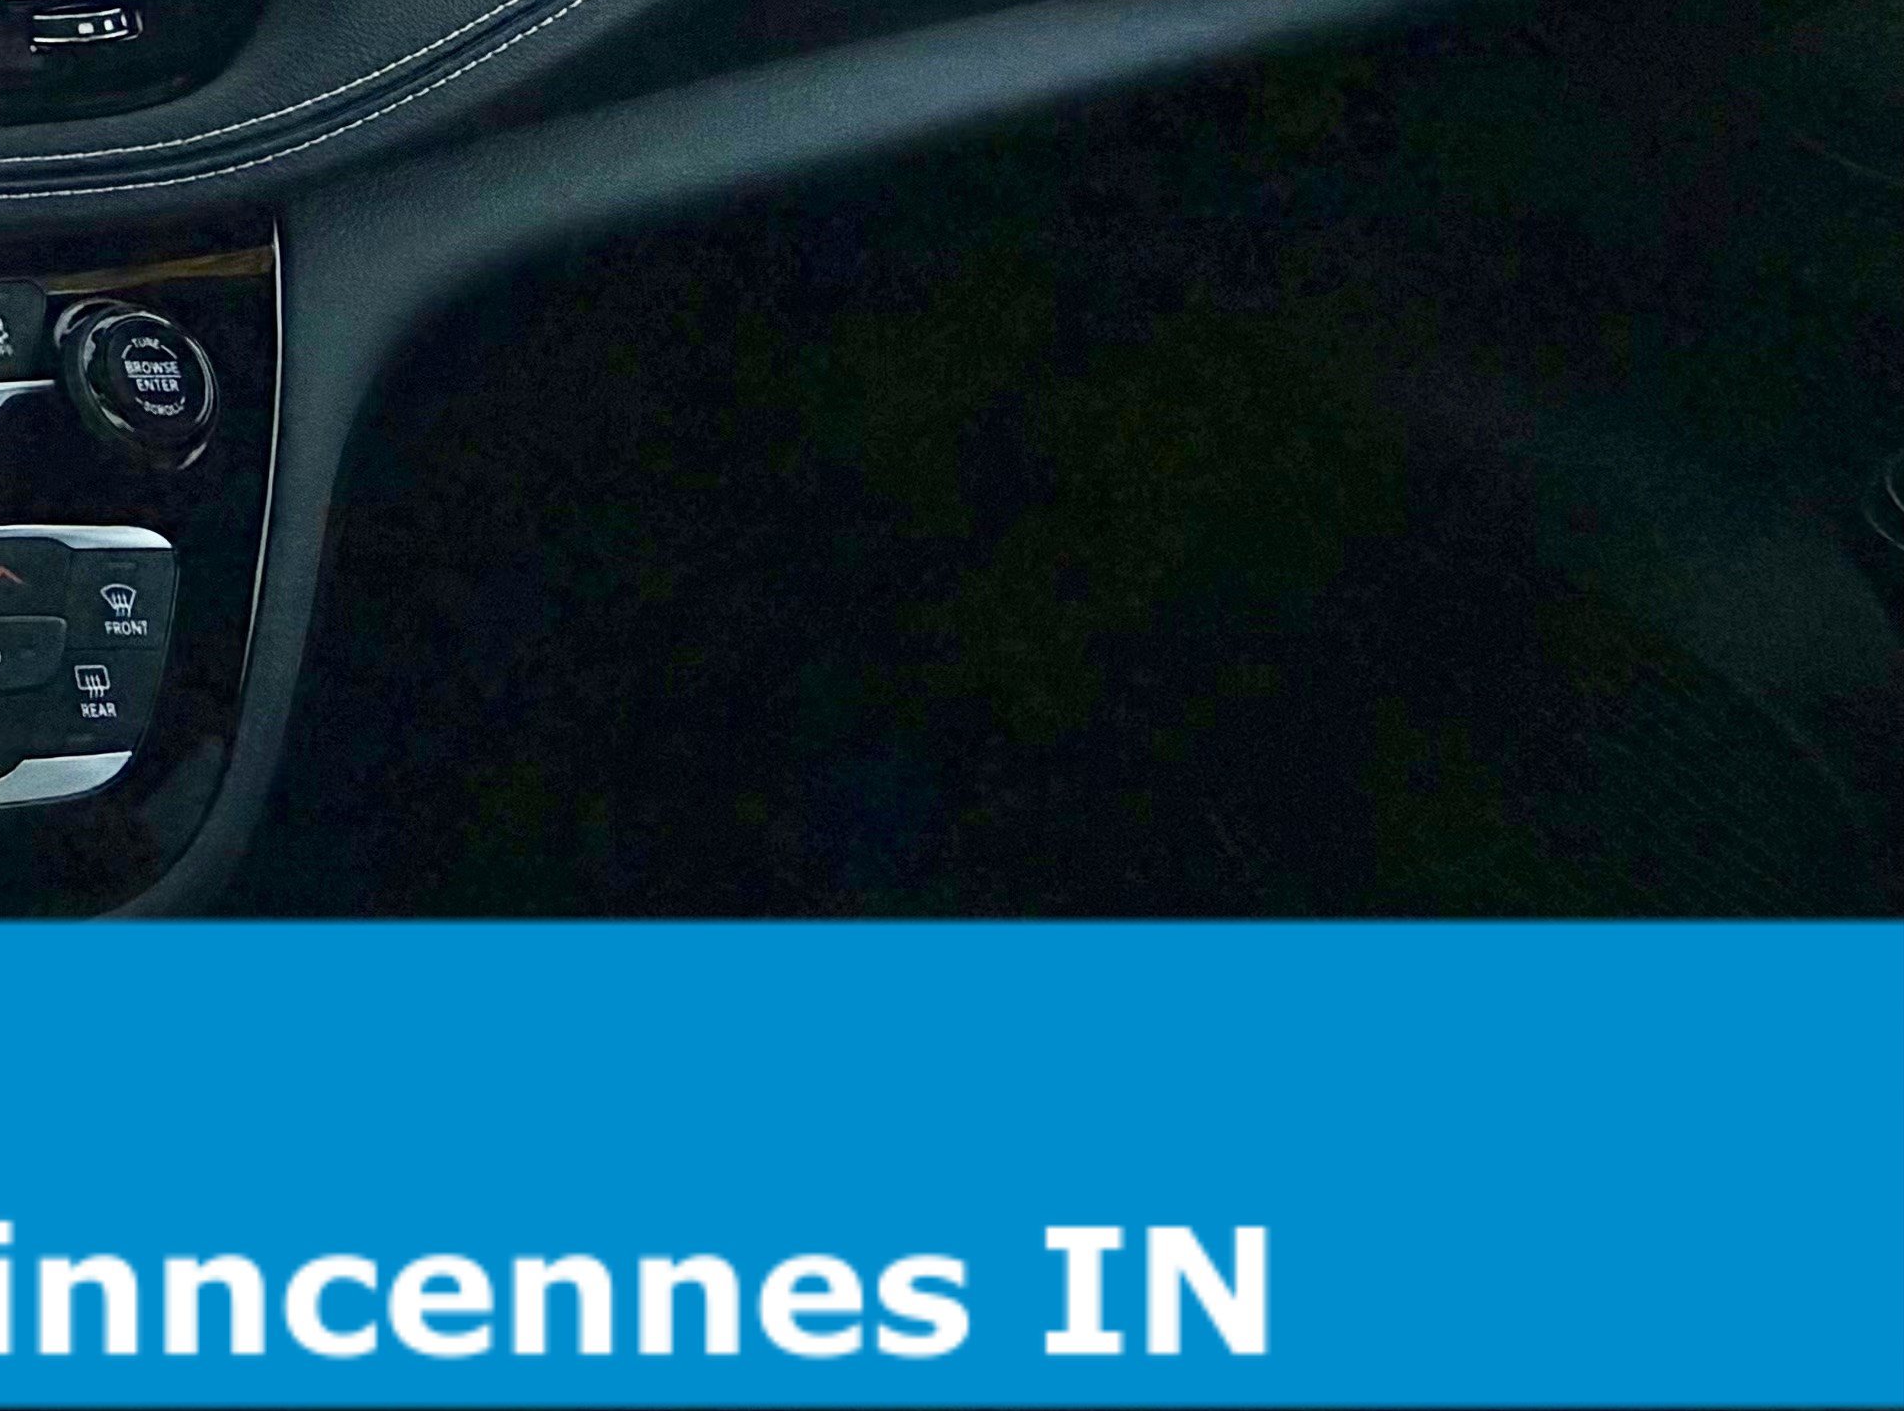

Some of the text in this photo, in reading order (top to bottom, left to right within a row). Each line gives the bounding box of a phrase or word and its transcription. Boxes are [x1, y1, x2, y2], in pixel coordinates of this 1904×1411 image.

[124, 360, 181, 374] BROWSE
[136, 378, 181, 393] ENTER
[104, 620, 148, 636] FRONT
[80, 702, 117, 718] REAR
